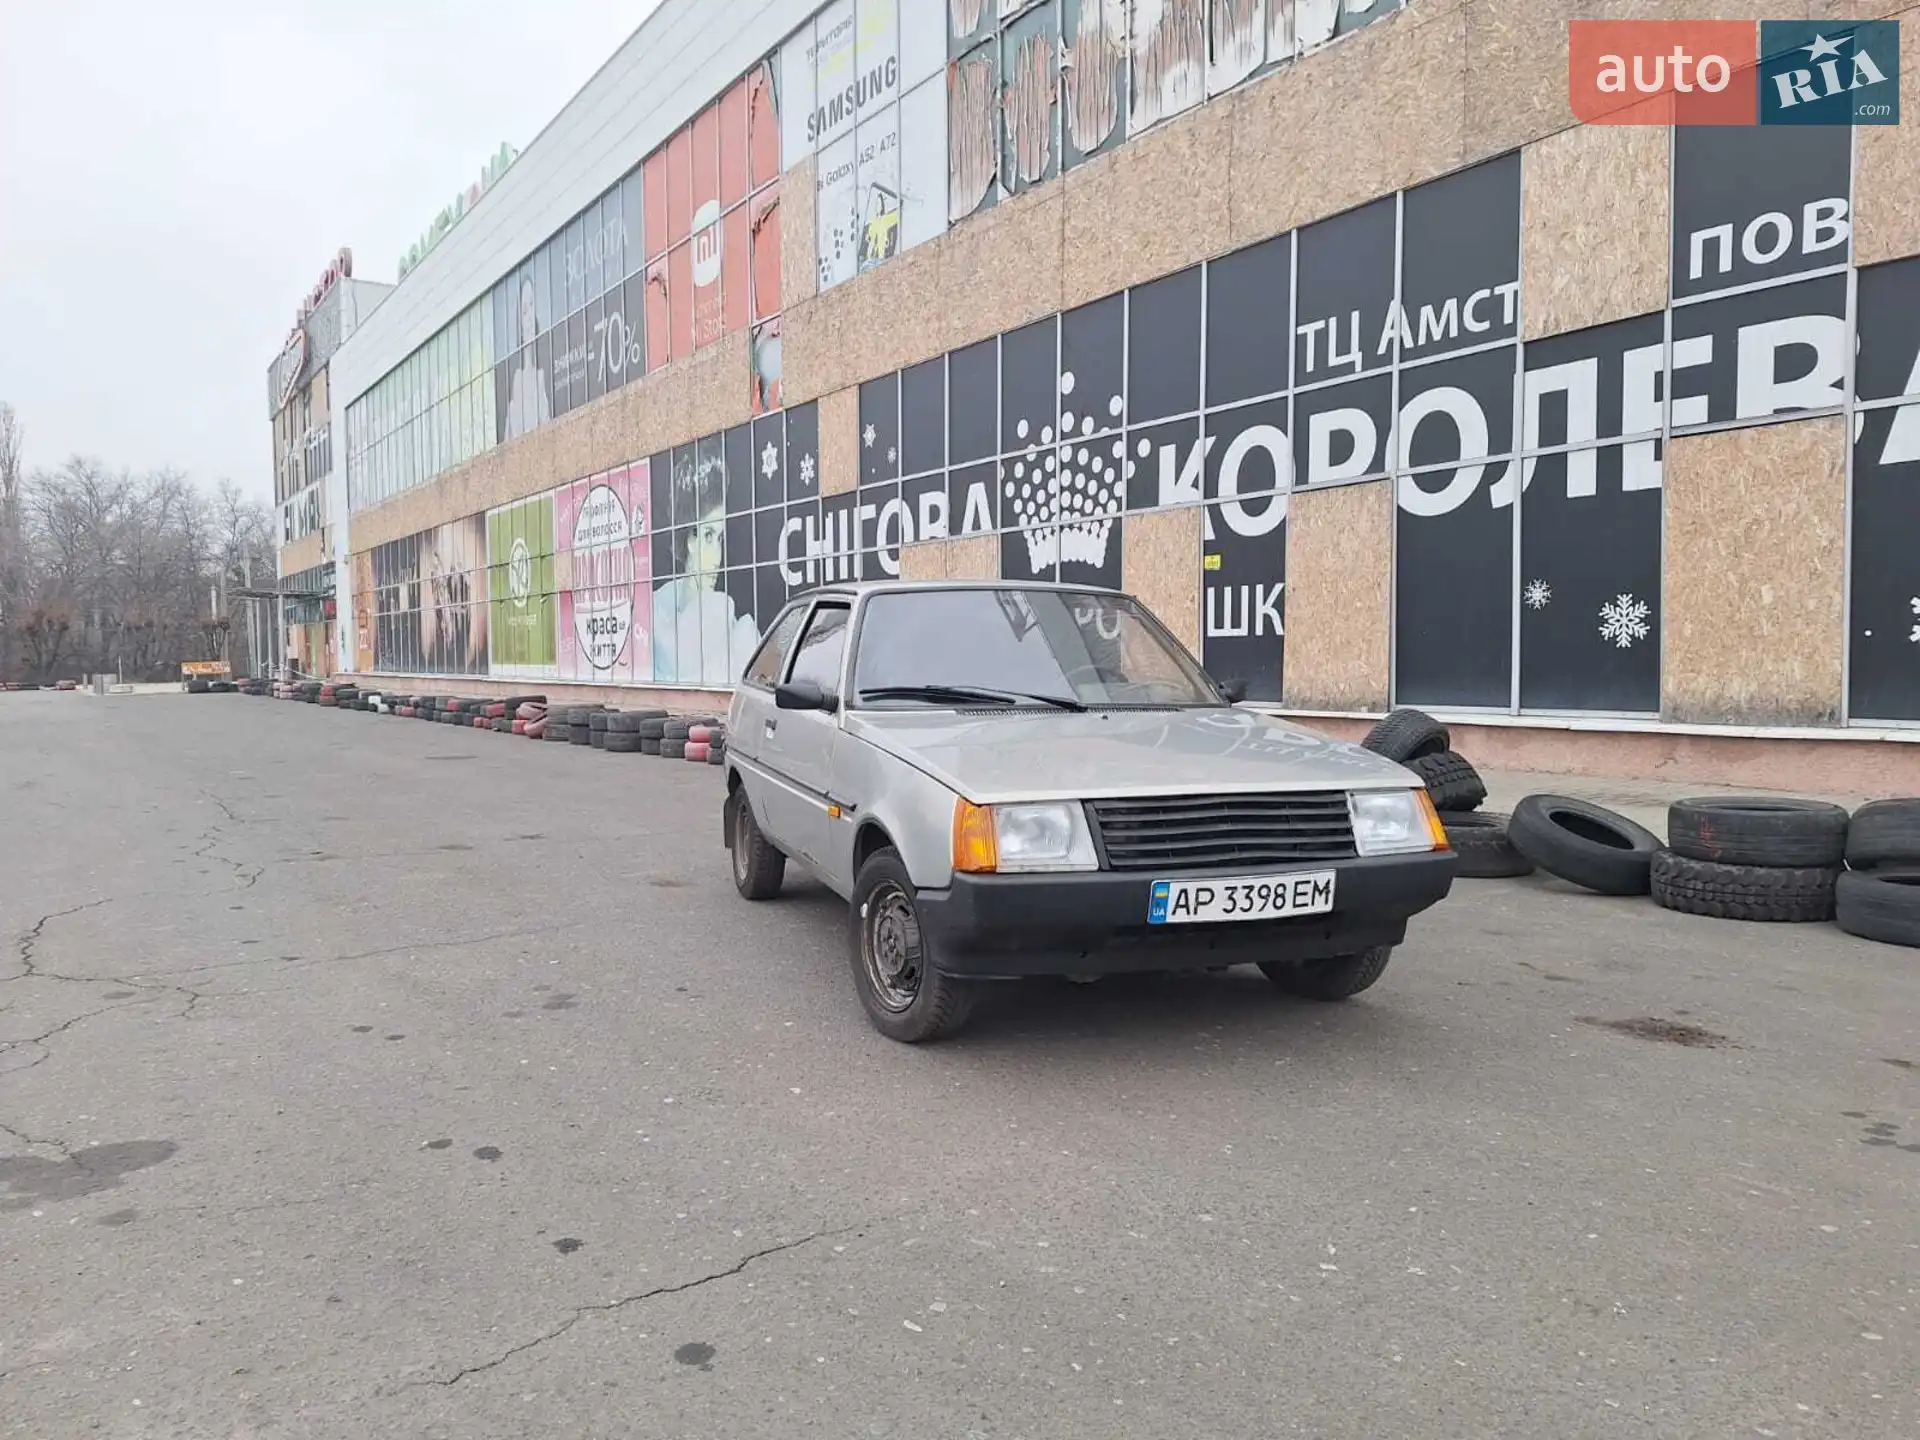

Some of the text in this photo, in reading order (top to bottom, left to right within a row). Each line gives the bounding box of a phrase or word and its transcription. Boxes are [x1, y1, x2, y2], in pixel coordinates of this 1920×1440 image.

[807, 55, 896, 142] SAMSUNG
[826, 162, 855, 186] Galaxy
[1297, 309, 1362, 373] ТЦ
[778, 482, 995, 586] СНІГОВА
[1153, 907, 1165, 916] UA
[1171, 878, 1331, 916] AP 3398 EM
